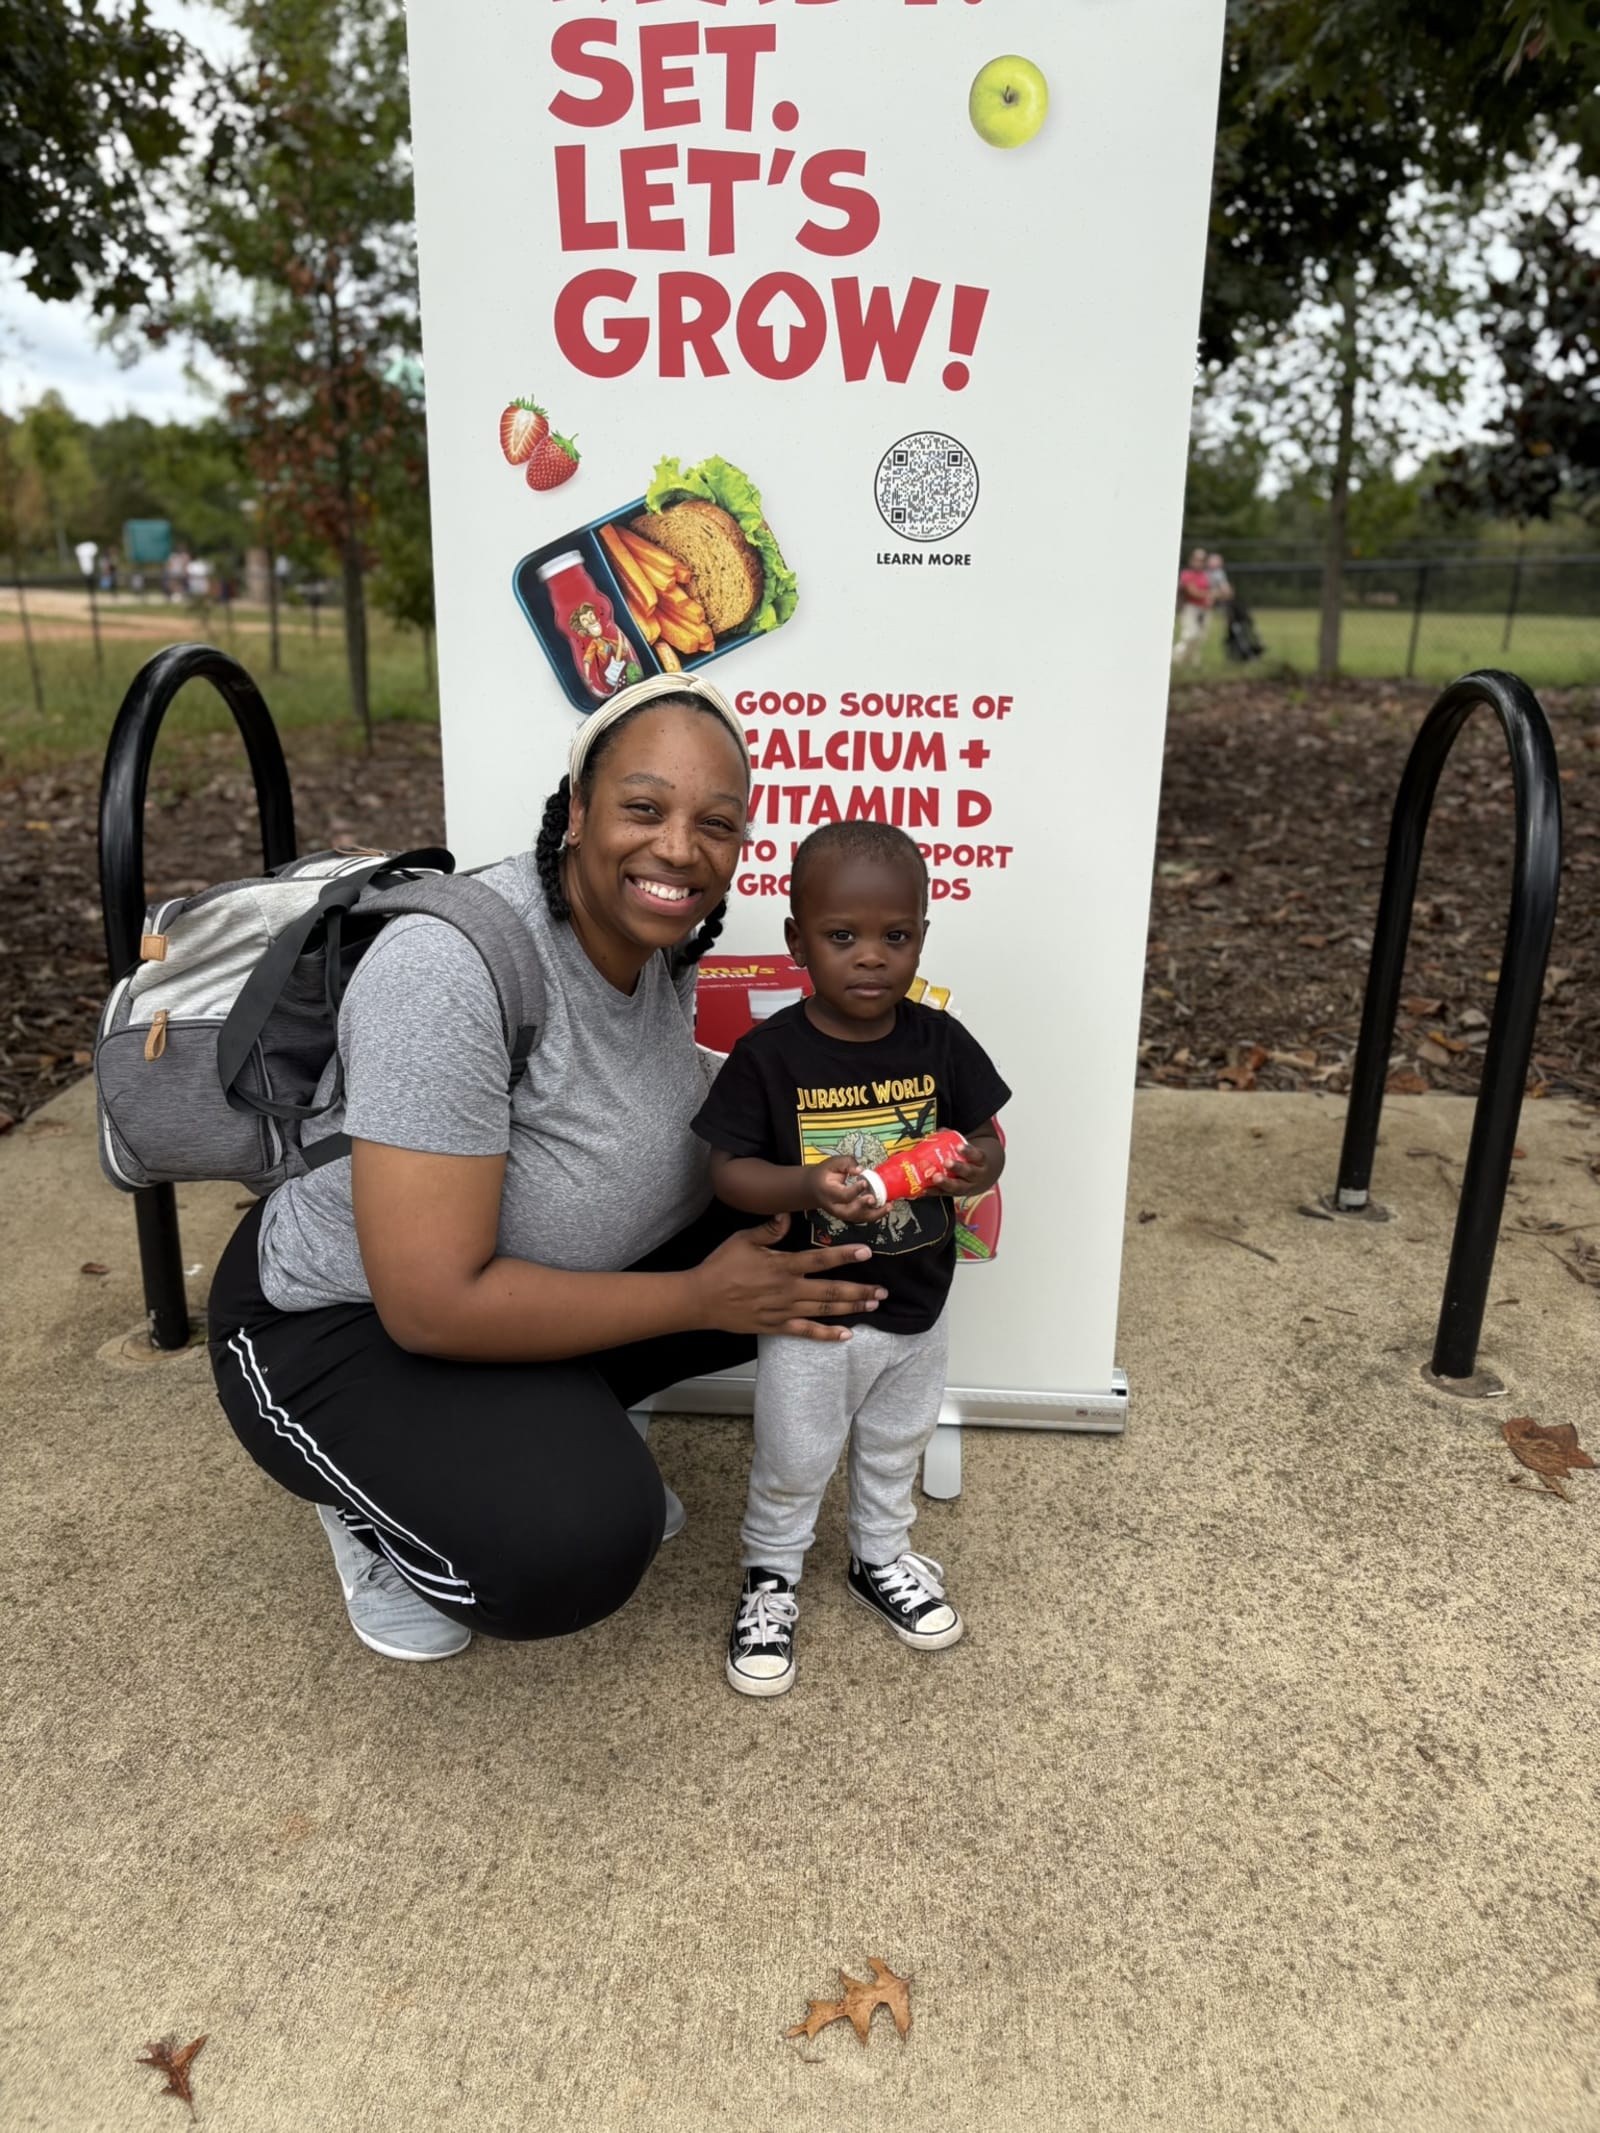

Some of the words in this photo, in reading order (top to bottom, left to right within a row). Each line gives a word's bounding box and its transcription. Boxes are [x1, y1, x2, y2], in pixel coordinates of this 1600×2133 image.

[548, 17, 800, 132] SET.
[554, 143, 880, 257] LET'S
[554, 268, 990, 391] GROW!
[876, 552, 923, 566] LEARN
[928, 553, 972, 566] MORE
[735, 691, 827, 716] GOOD
[840, 692, 959, 719] SOURCE
[972, 695, 1014, 720] OF
[959, 739, 991, 769] +
[957, 789, 993, 828] D
[740, 839, 777, 863] TO
[914, 843, 1014, 869] PPORT
[929, 877, 972, 901] DS
[796, 1086, 869, 1110] JURASSIC
[871, 1074, 936, 1104] WORLD
